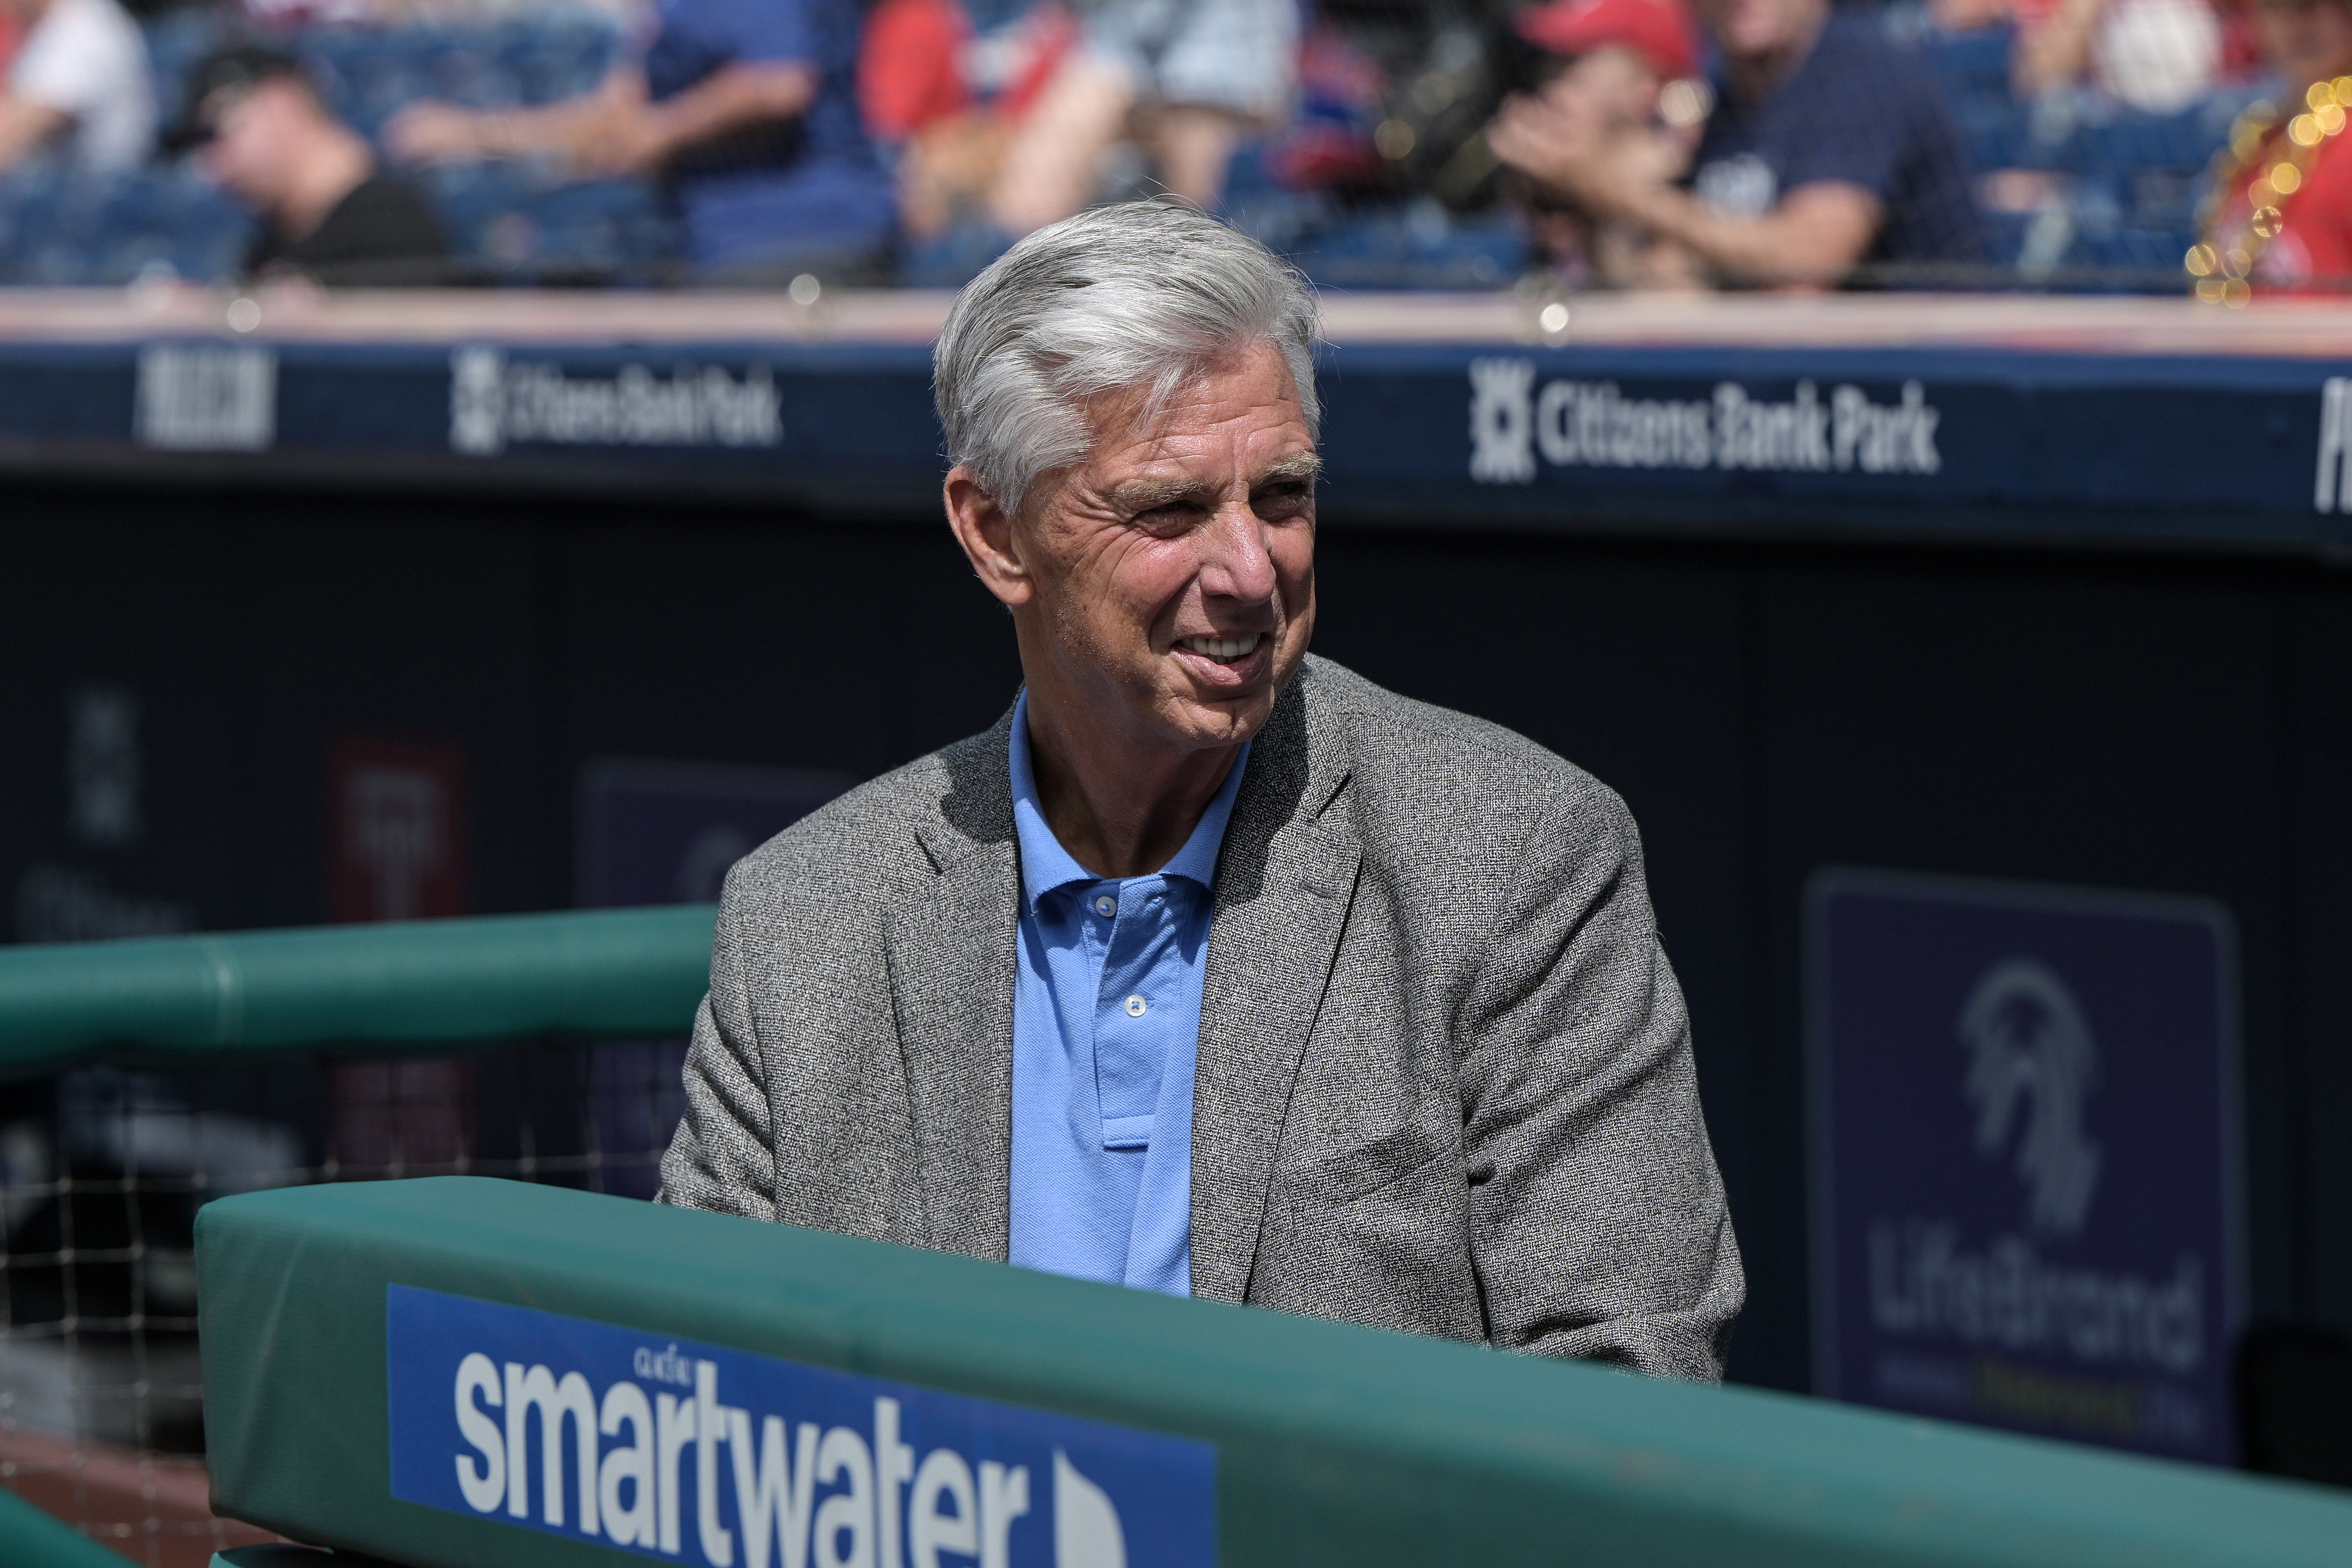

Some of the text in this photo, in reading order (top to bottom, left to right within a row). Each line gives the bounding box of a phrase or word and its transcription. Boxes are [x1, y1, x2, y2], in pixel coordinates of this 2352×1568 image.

[703, 362, 784, 447] Park
[1537, 379, 1941, 474] Citizens Bank Park
[1867, 1216, 2206, 1371] LifeBrand
[454, 1352, 1030, 1568] smartwater
